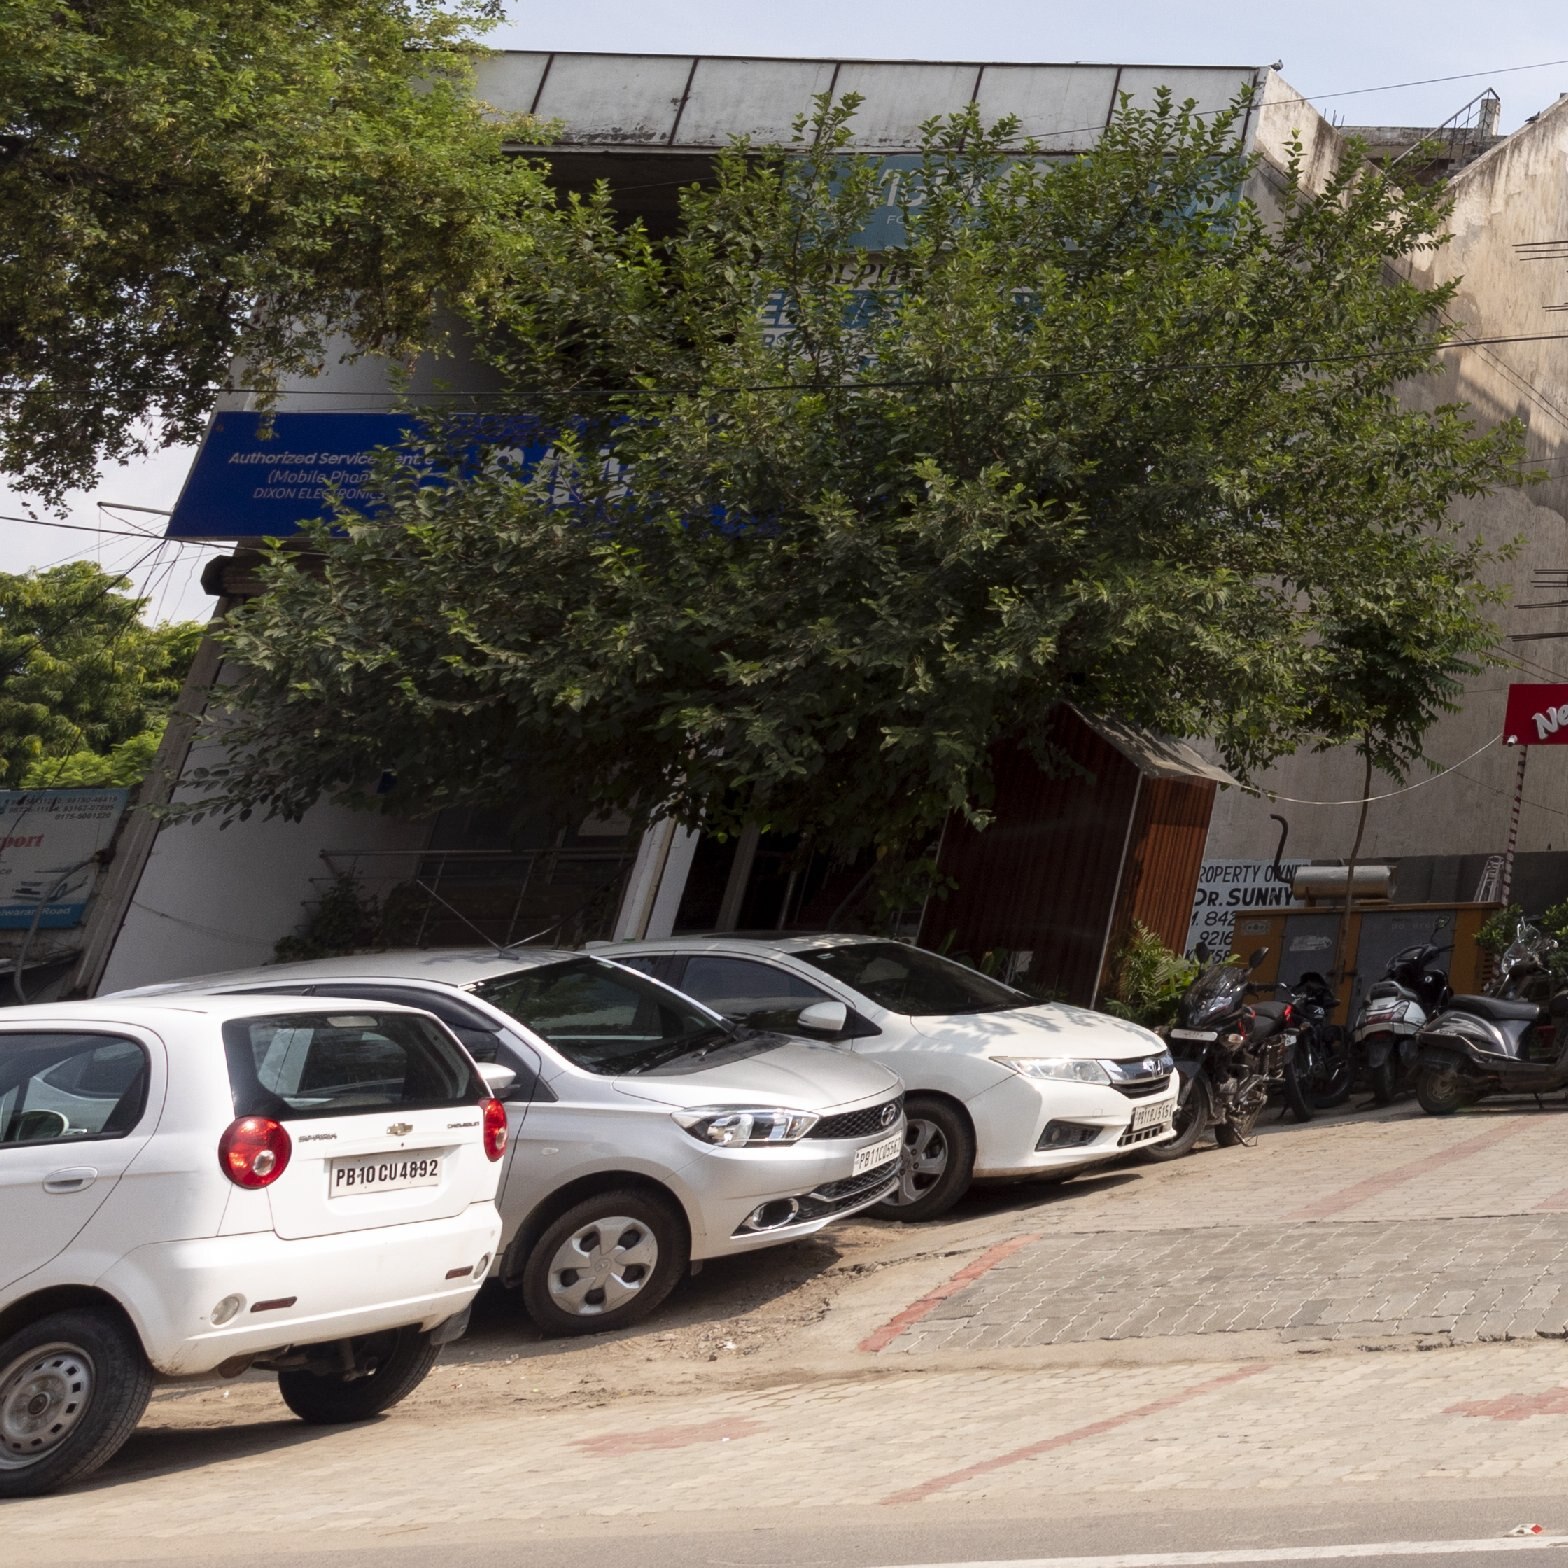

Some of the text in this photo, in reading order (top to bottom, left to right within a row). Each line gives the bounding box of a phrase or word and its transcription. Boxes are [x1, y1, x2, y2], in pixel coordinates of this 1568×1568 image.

[229, 451, 317, 465] Authorized
[319, 451, 375, 465] Service
[268, 469, 326, 483] (Mobile
[253, 487, 296, 499] DIXON
[0, 833, 45, 848] port
